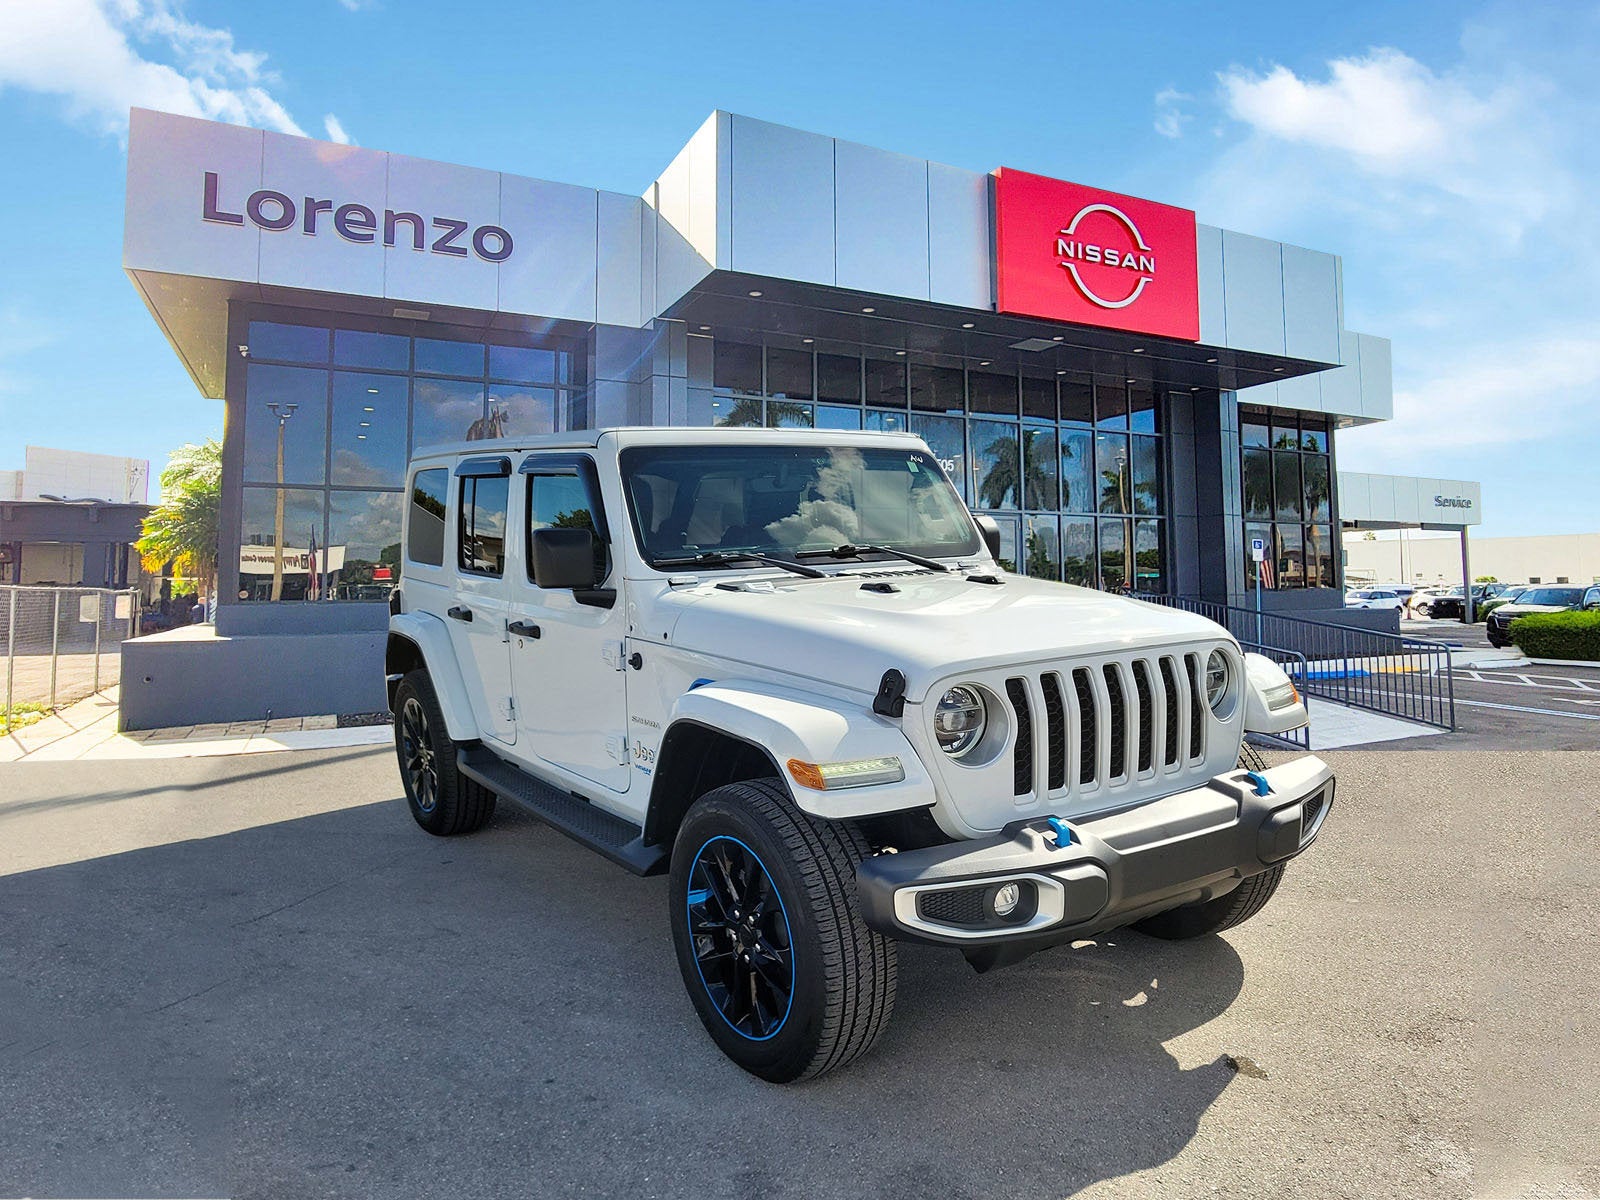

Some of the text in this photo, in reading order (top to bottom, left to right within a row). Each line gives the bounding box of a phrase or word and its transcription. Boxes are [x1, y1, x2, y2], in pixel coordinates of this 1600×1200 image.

[202, 171, 514, 262] Lorenzo
[1057, 238, 1155, 273] NISSAN
[1434, 495, 1472, 508] Service
